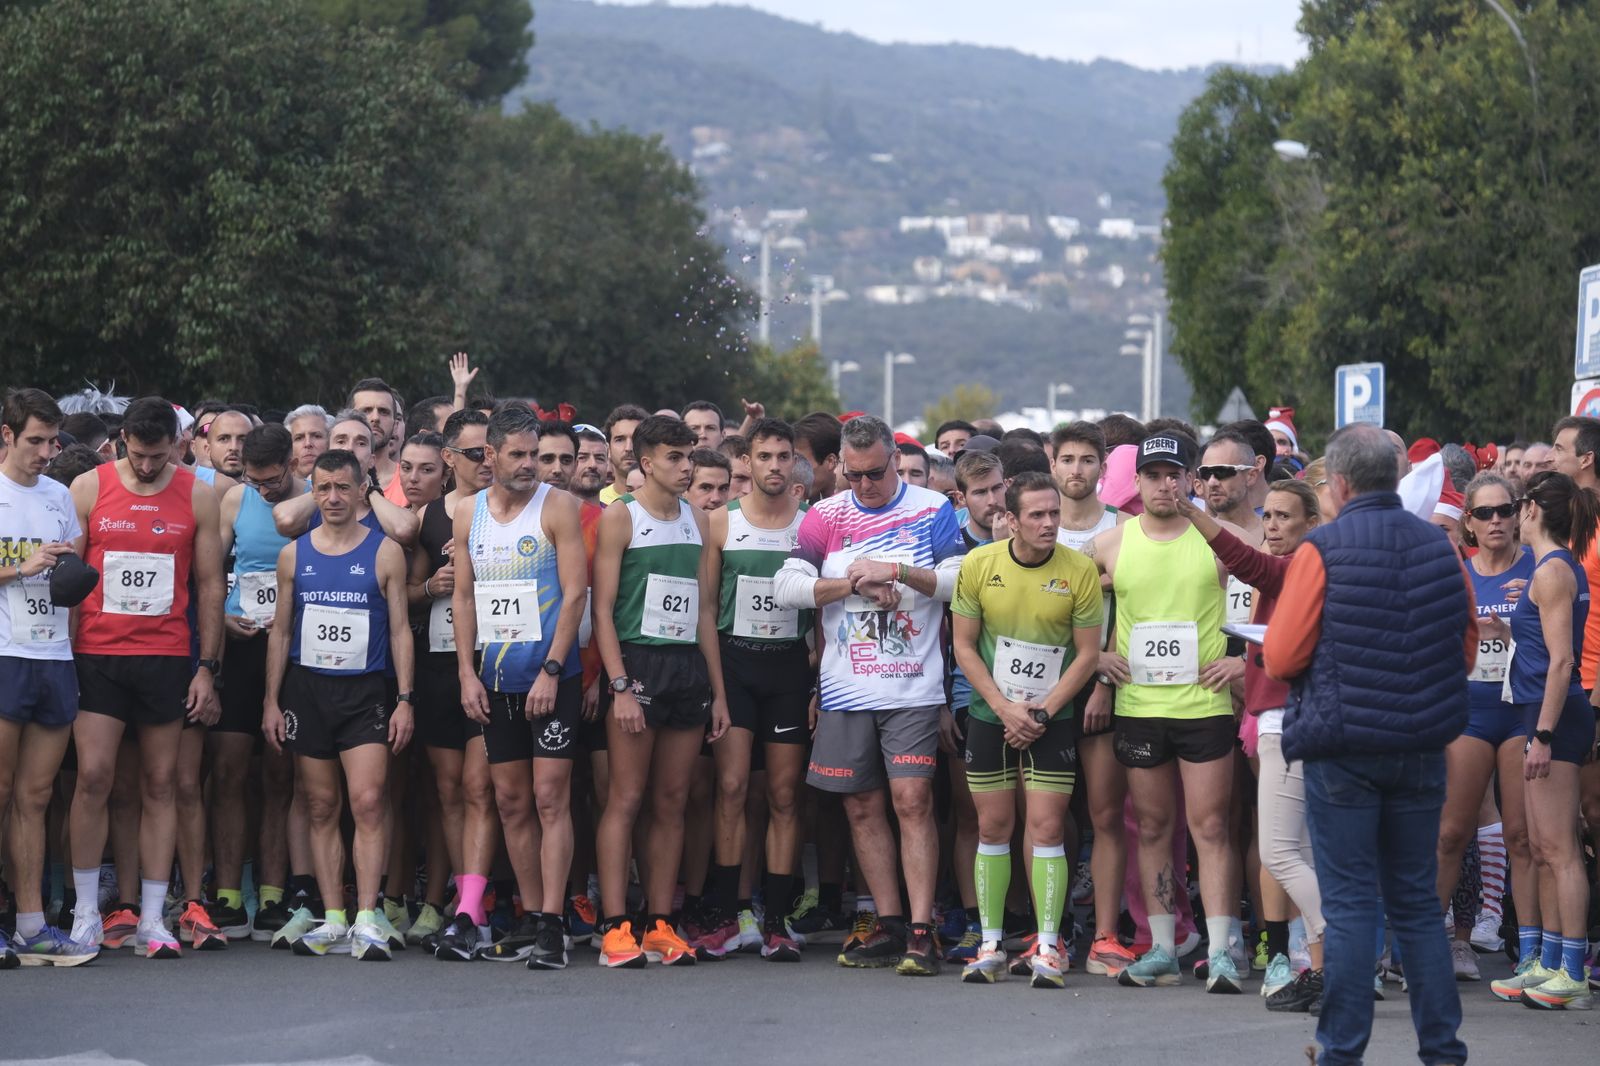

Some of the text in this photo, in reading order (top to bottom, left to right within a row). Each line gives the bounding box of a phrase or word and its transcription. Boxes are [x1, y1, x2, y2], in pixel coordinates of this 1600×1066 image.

[1345, 373, 1372, 424] P
[1146, 439, 1175, 450] 226ERS
[107, 520, 136, 529] califas
[121, 570, 158, 588] 887
[257, 588, 276, 605] 80
[662, 594, 690, 614] 621
[1230, 591, 1252, 609] 78
[27, 598, 56, 615] 361
[491, 598, 520, 615] 271
[317, 624, 351, 643] 385
[727, 637, 762, 651] NIKE
[1145, 639, 1181, 657] 266
[1010, 658, 1046, 679] 842
